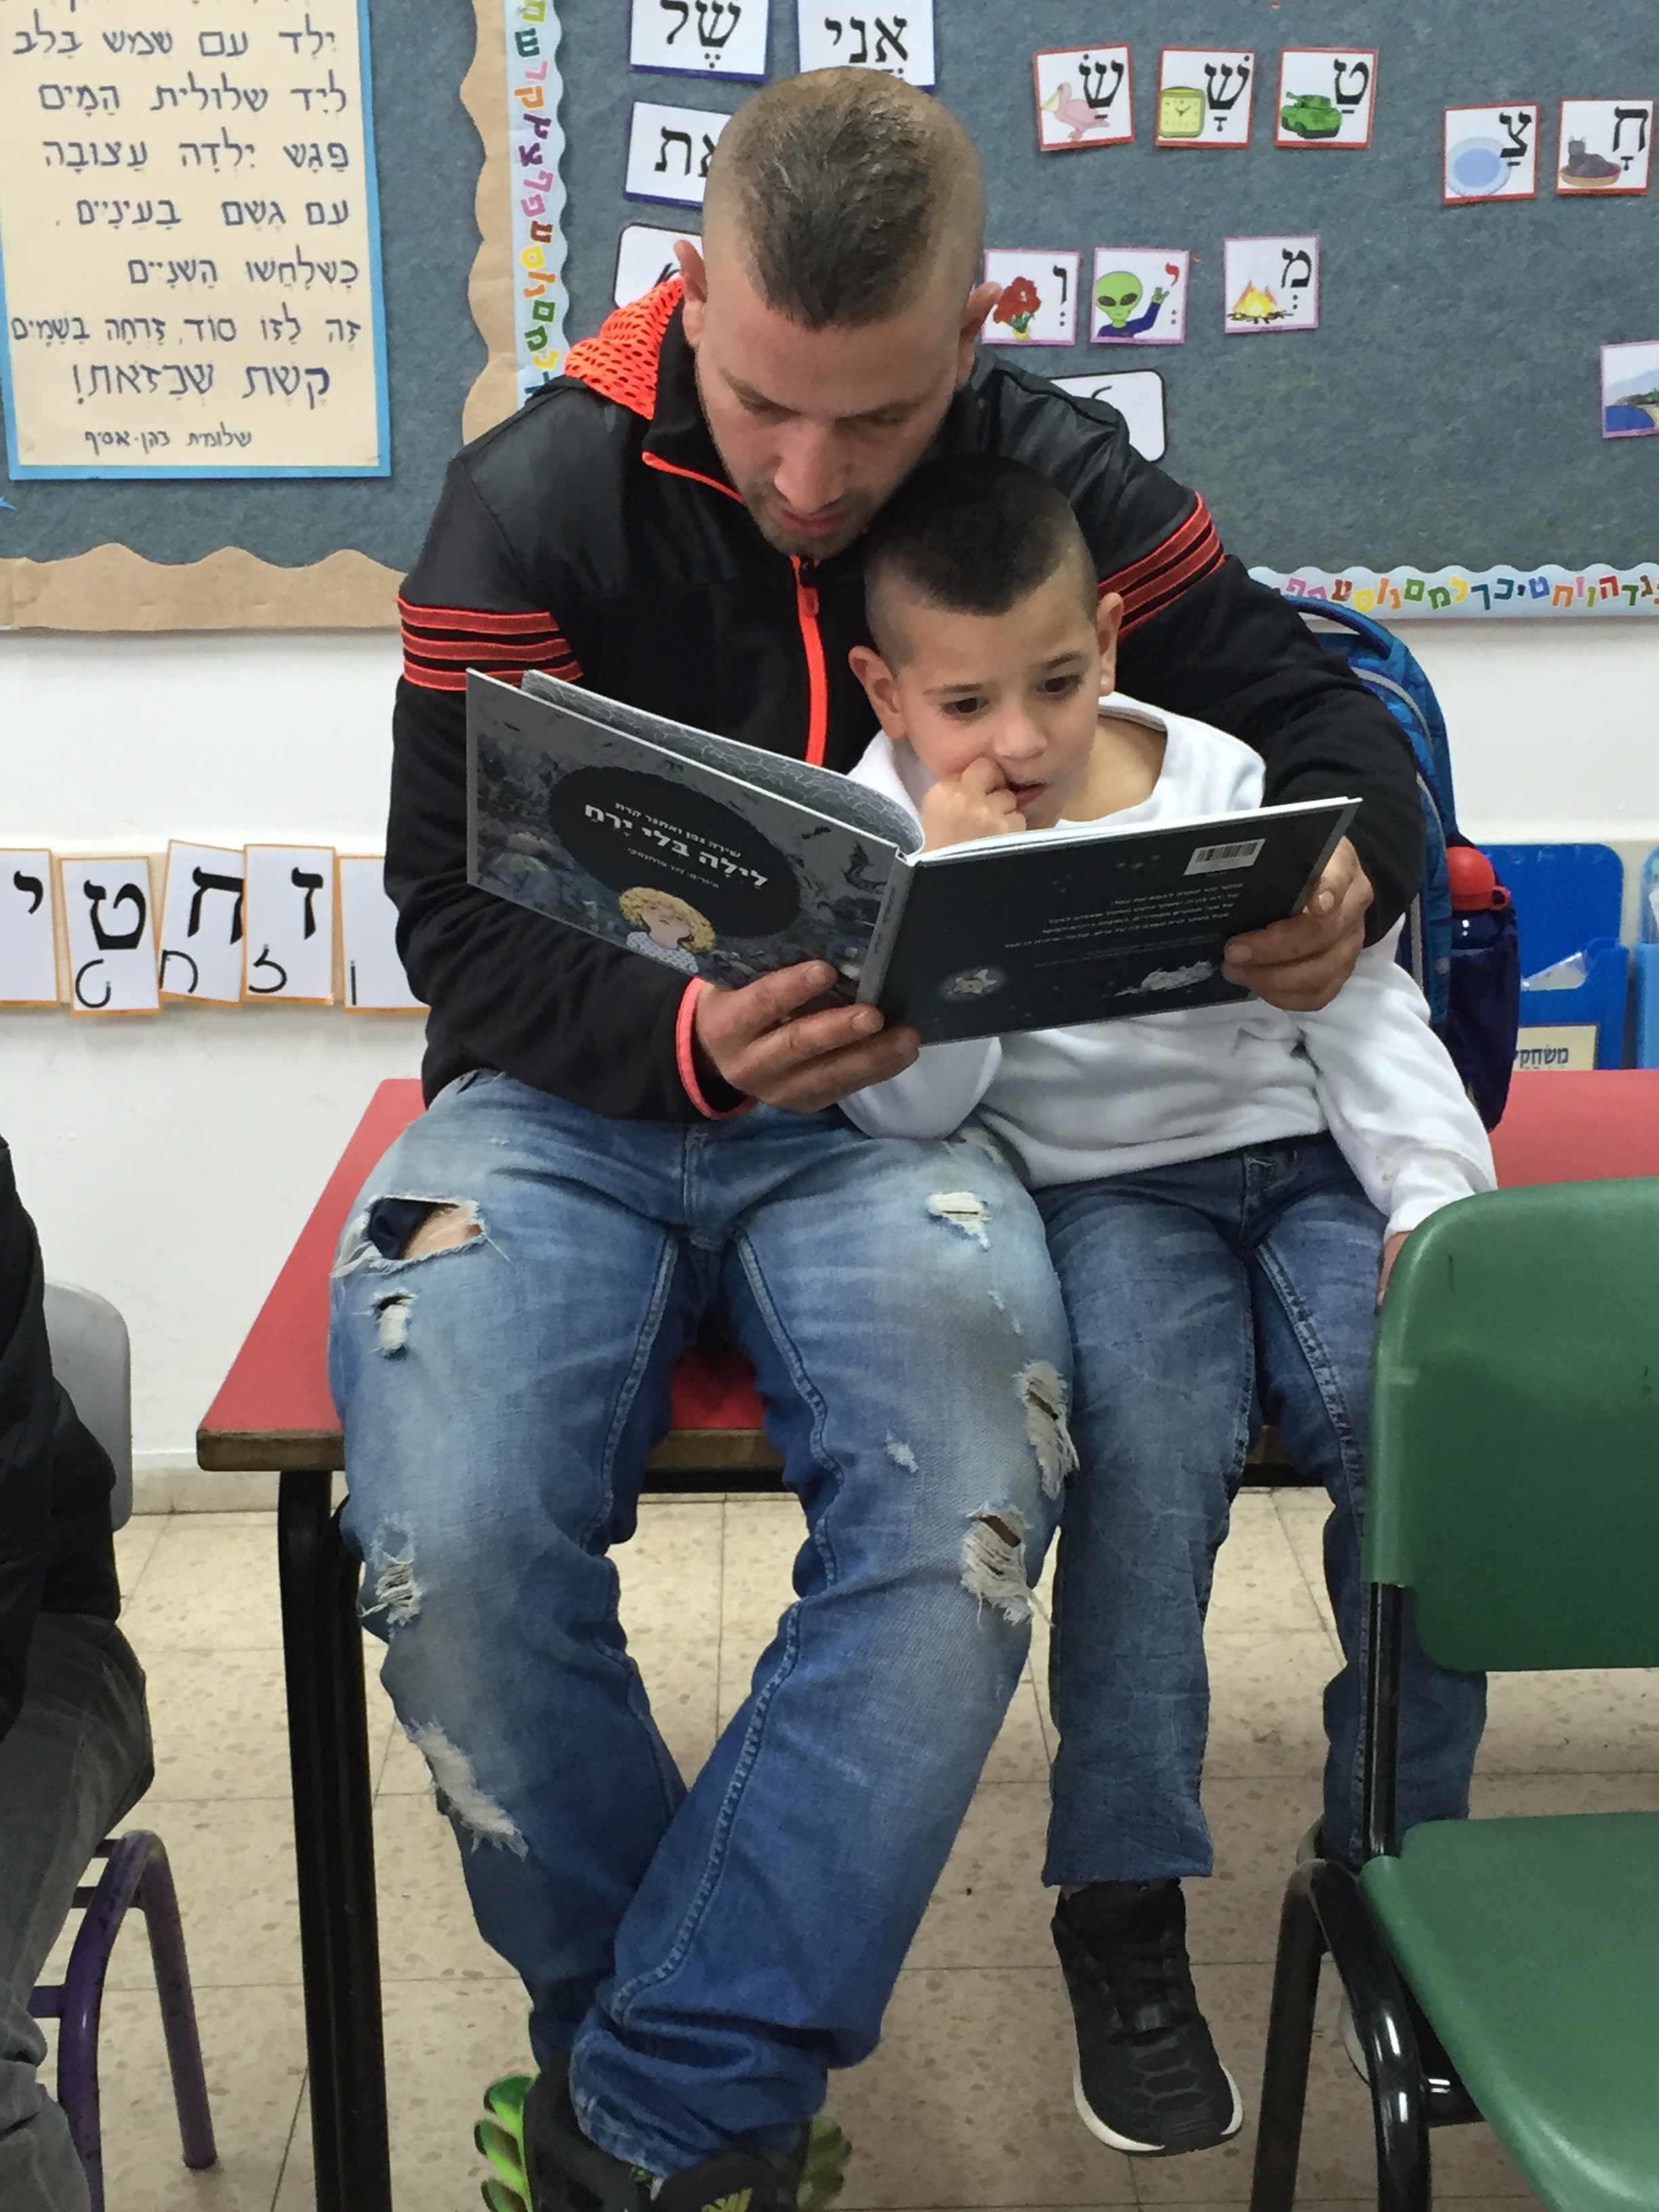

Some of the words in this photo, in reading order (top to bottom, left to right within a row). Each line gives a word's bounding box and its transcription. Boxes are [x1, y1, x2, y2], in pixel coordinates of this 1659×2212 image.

[14, 871, 43, 914] י
[83, 880, 146, 950] ט
[187, 866, 243, 945] ח
[291, 867, 323, 940] ז
